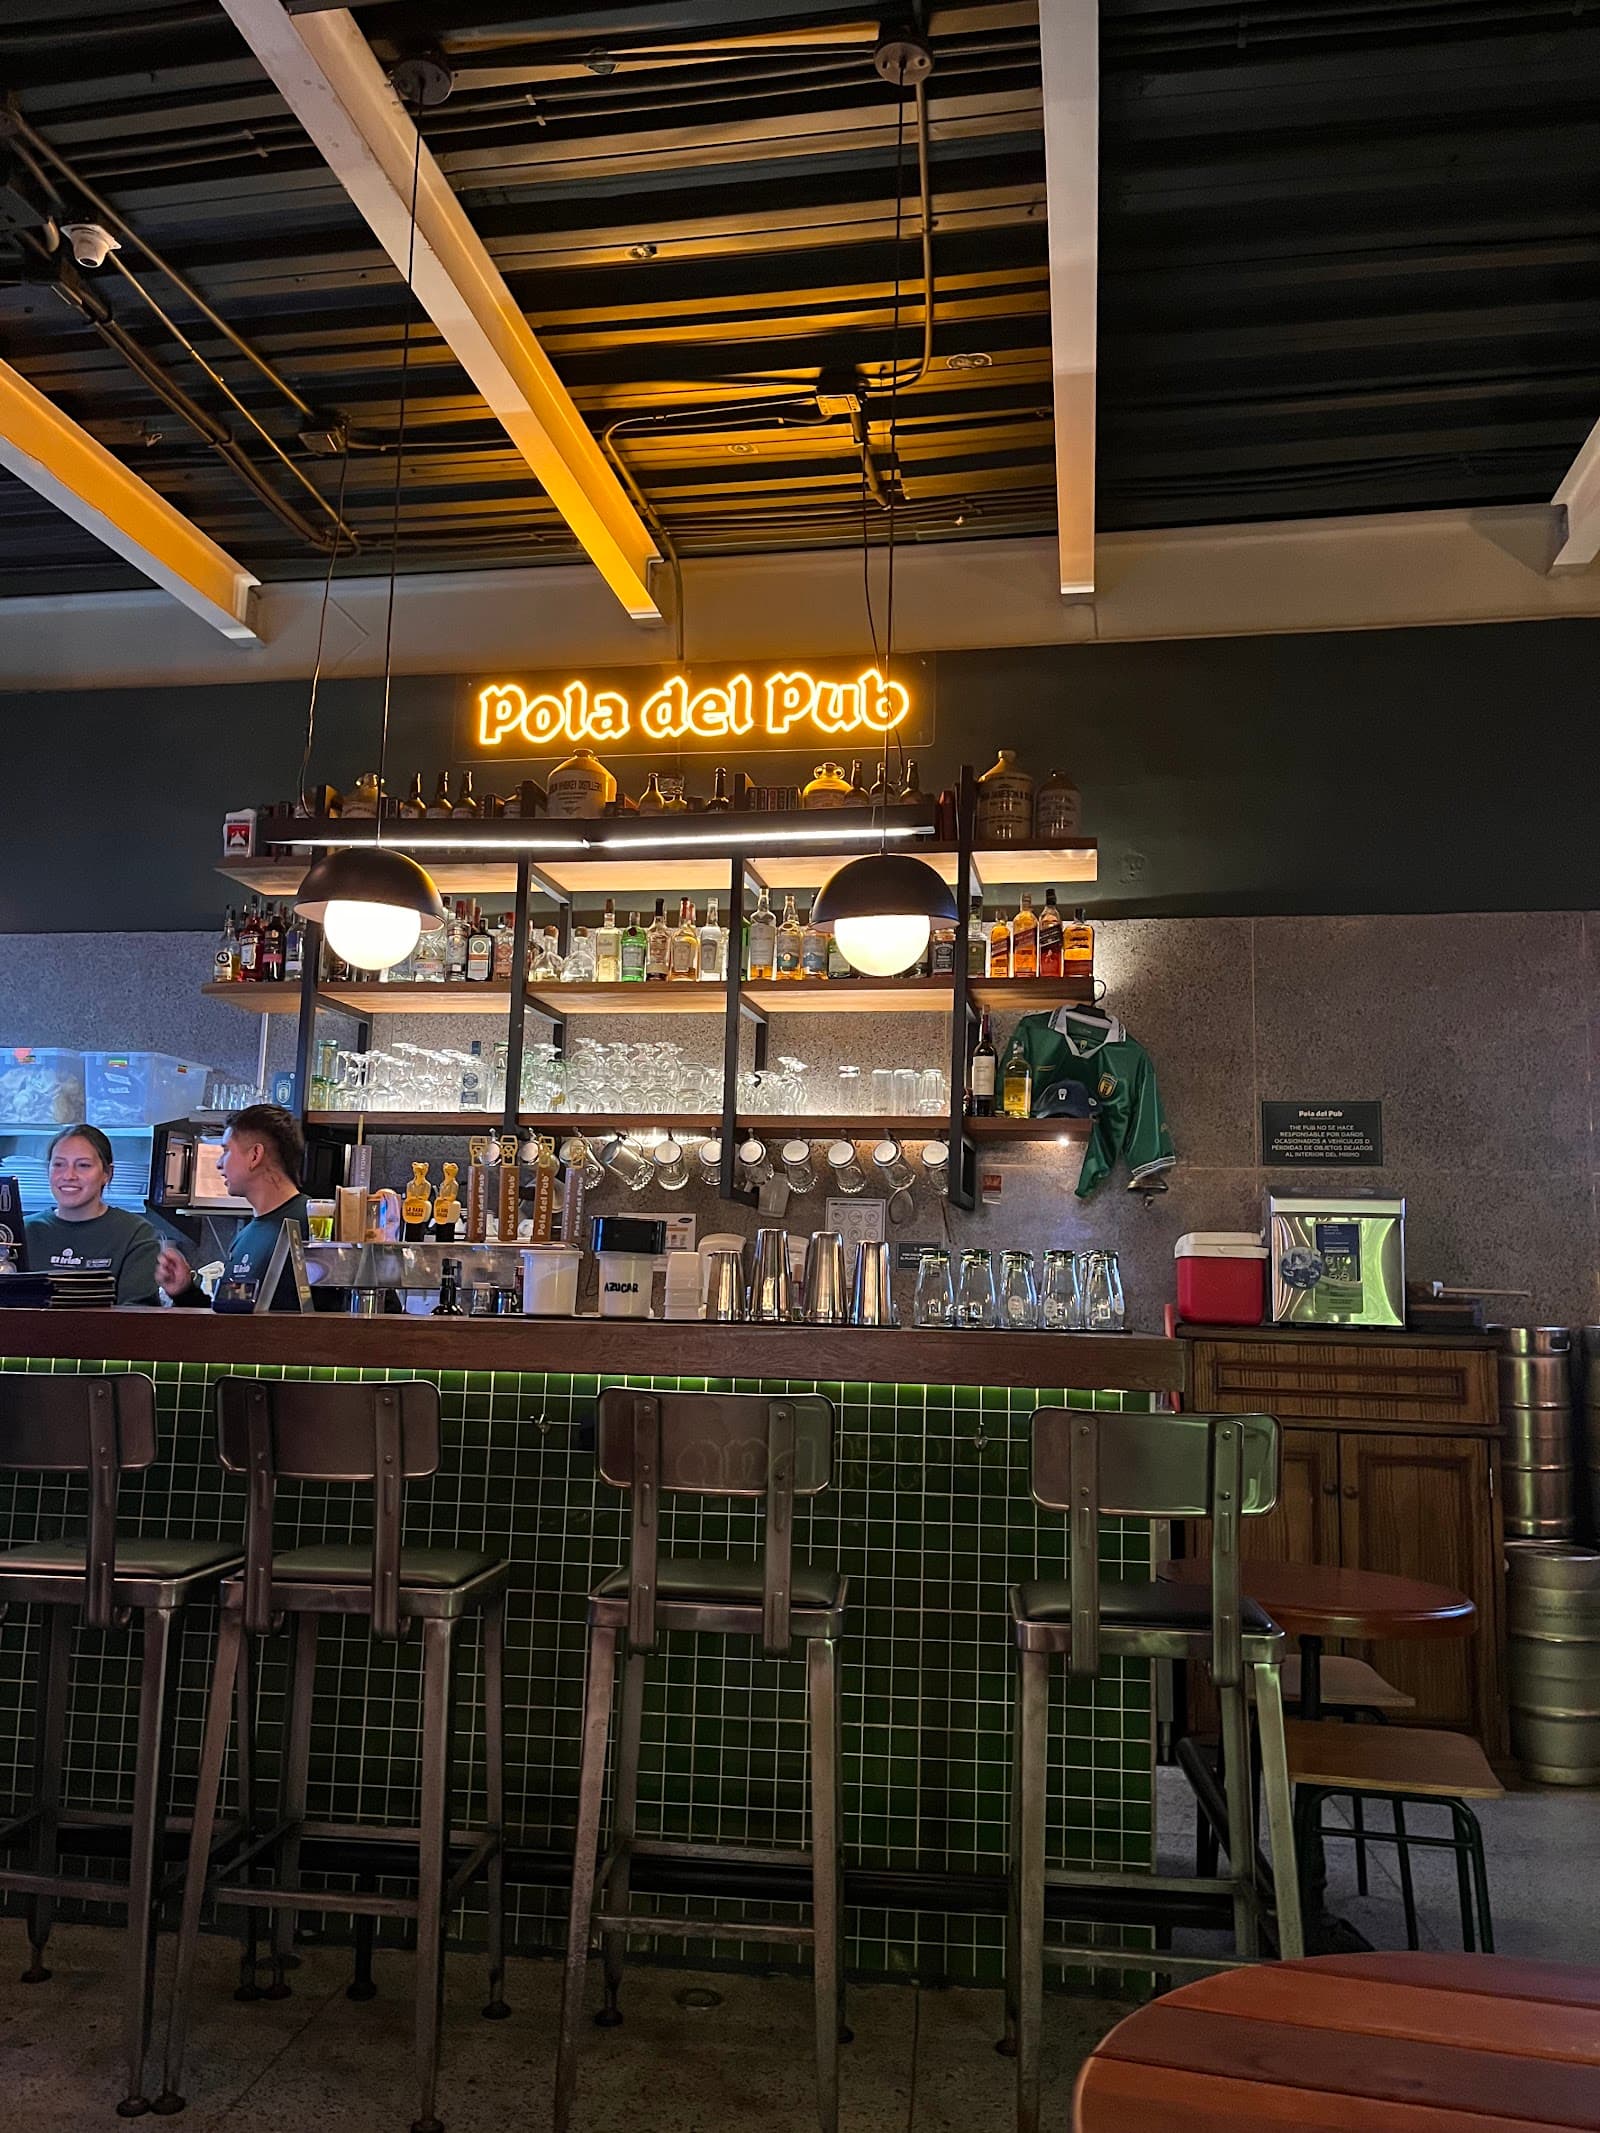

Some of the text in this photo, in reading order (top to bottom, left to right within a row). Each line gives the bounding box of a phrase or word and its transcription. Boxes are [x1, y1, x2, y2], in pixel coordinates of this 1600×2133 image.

[478, 668, 909, 745] Pola del Pub
[507, 1213, 515, 1236] Pola
[538, 1175, 549, 1236] Pola del Pub
[604, 1282, 639, 1293] AZUCAR
